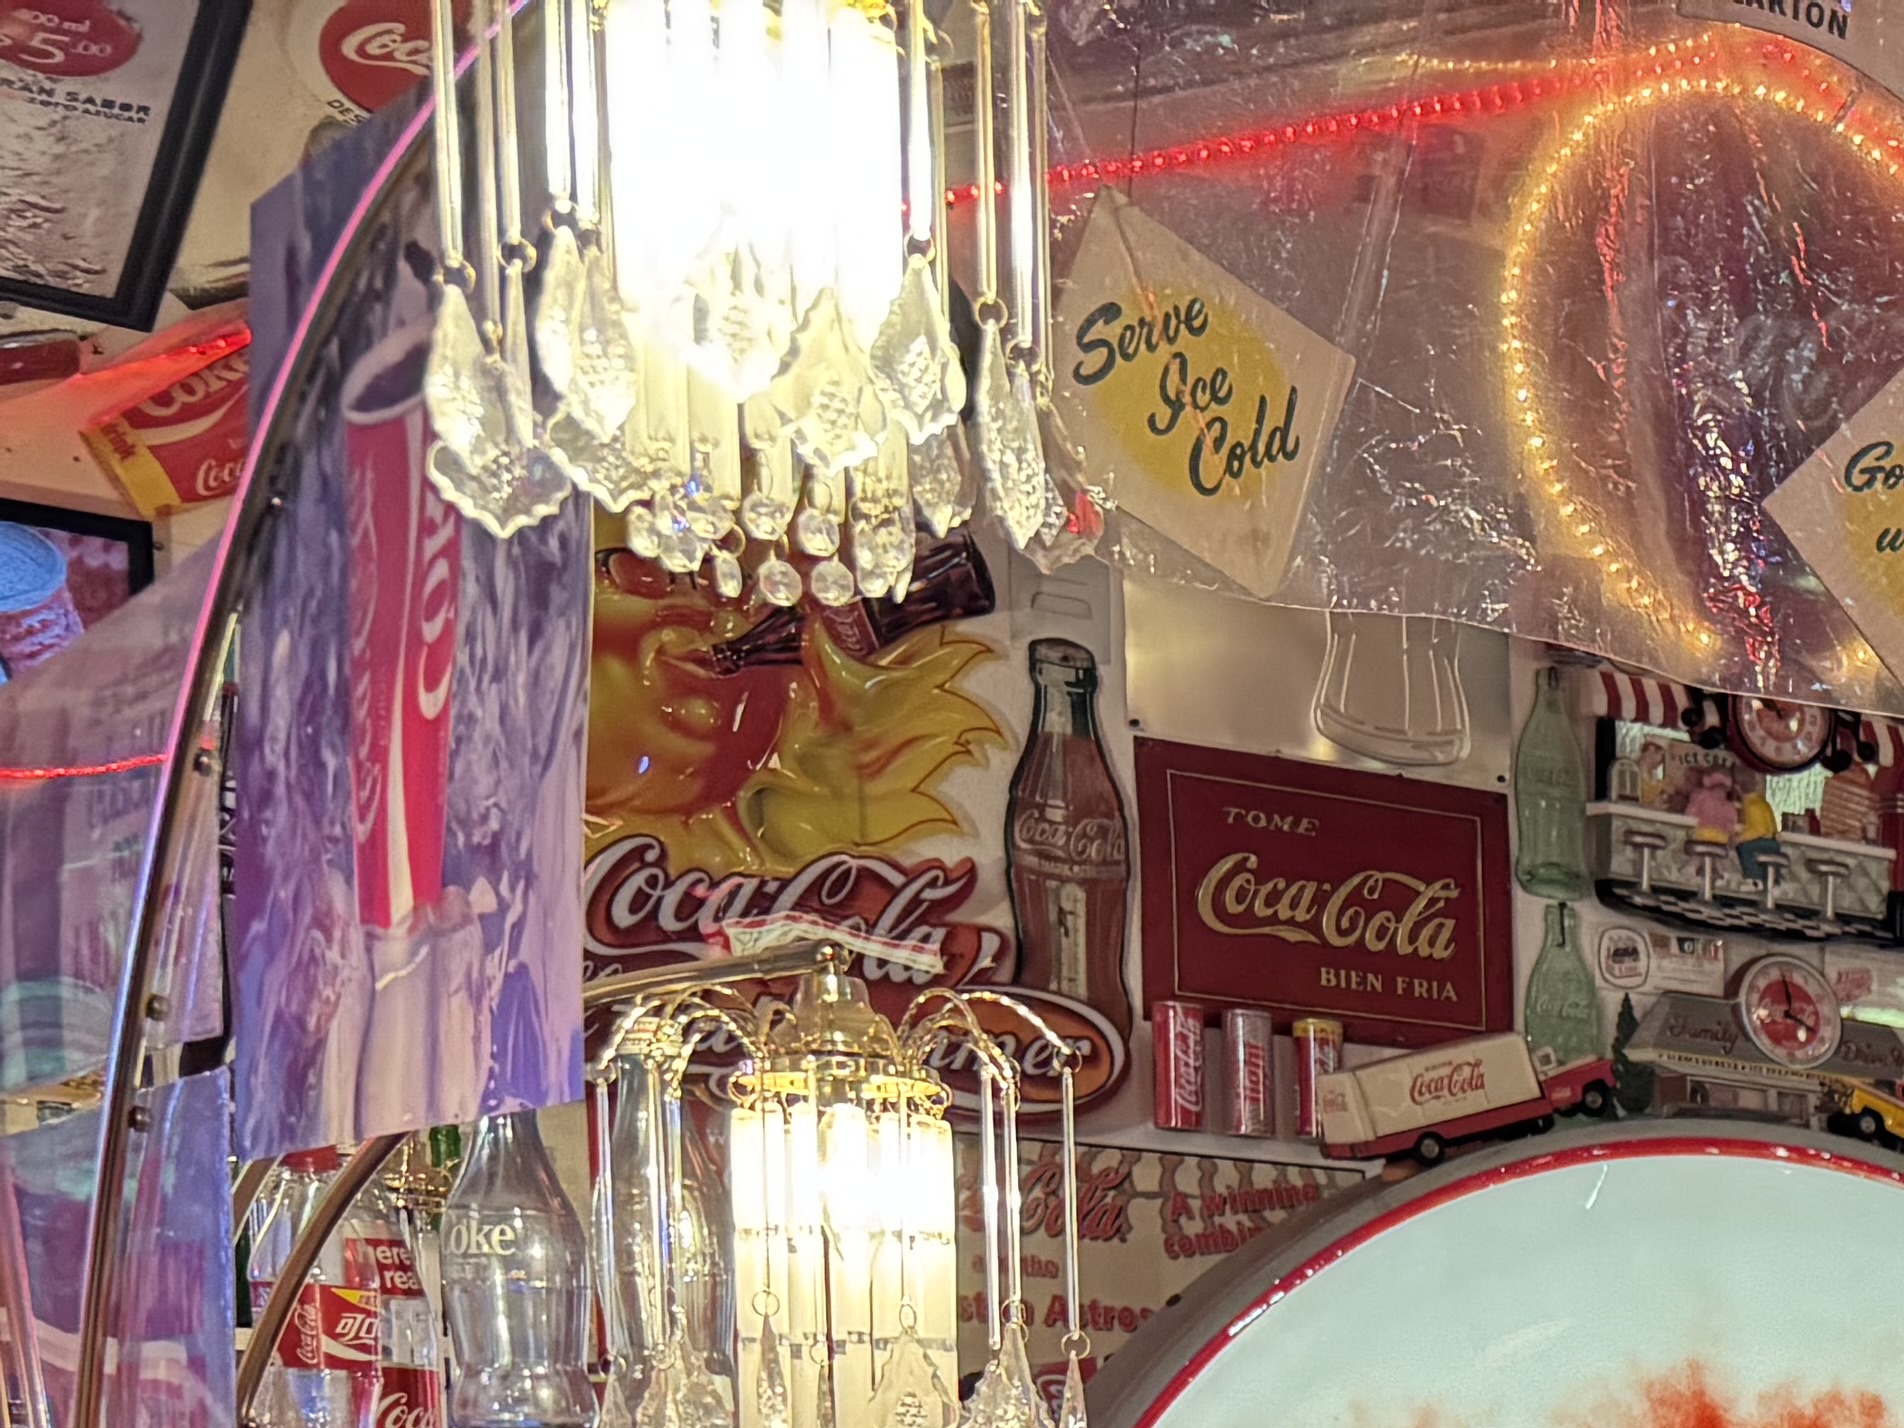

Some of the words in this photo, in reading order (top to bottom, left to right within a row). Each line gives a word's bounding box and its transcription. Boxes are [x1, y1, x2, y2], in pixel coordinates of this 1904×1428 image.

[1072, 295, 1209, 385] Serve
[1148, 354, 1234, 437] Ice
[1188, 385, 1300, 497] Cold
[1221, 805, 1319, 839] TOME
[1197, 850, 1460, 963] Coca-Cola
[1319, 966, 1383, 994] BIEN
[1394, 975, 1459, 1002] FRIA
[1669, 1012, 1741, 1054] Family
